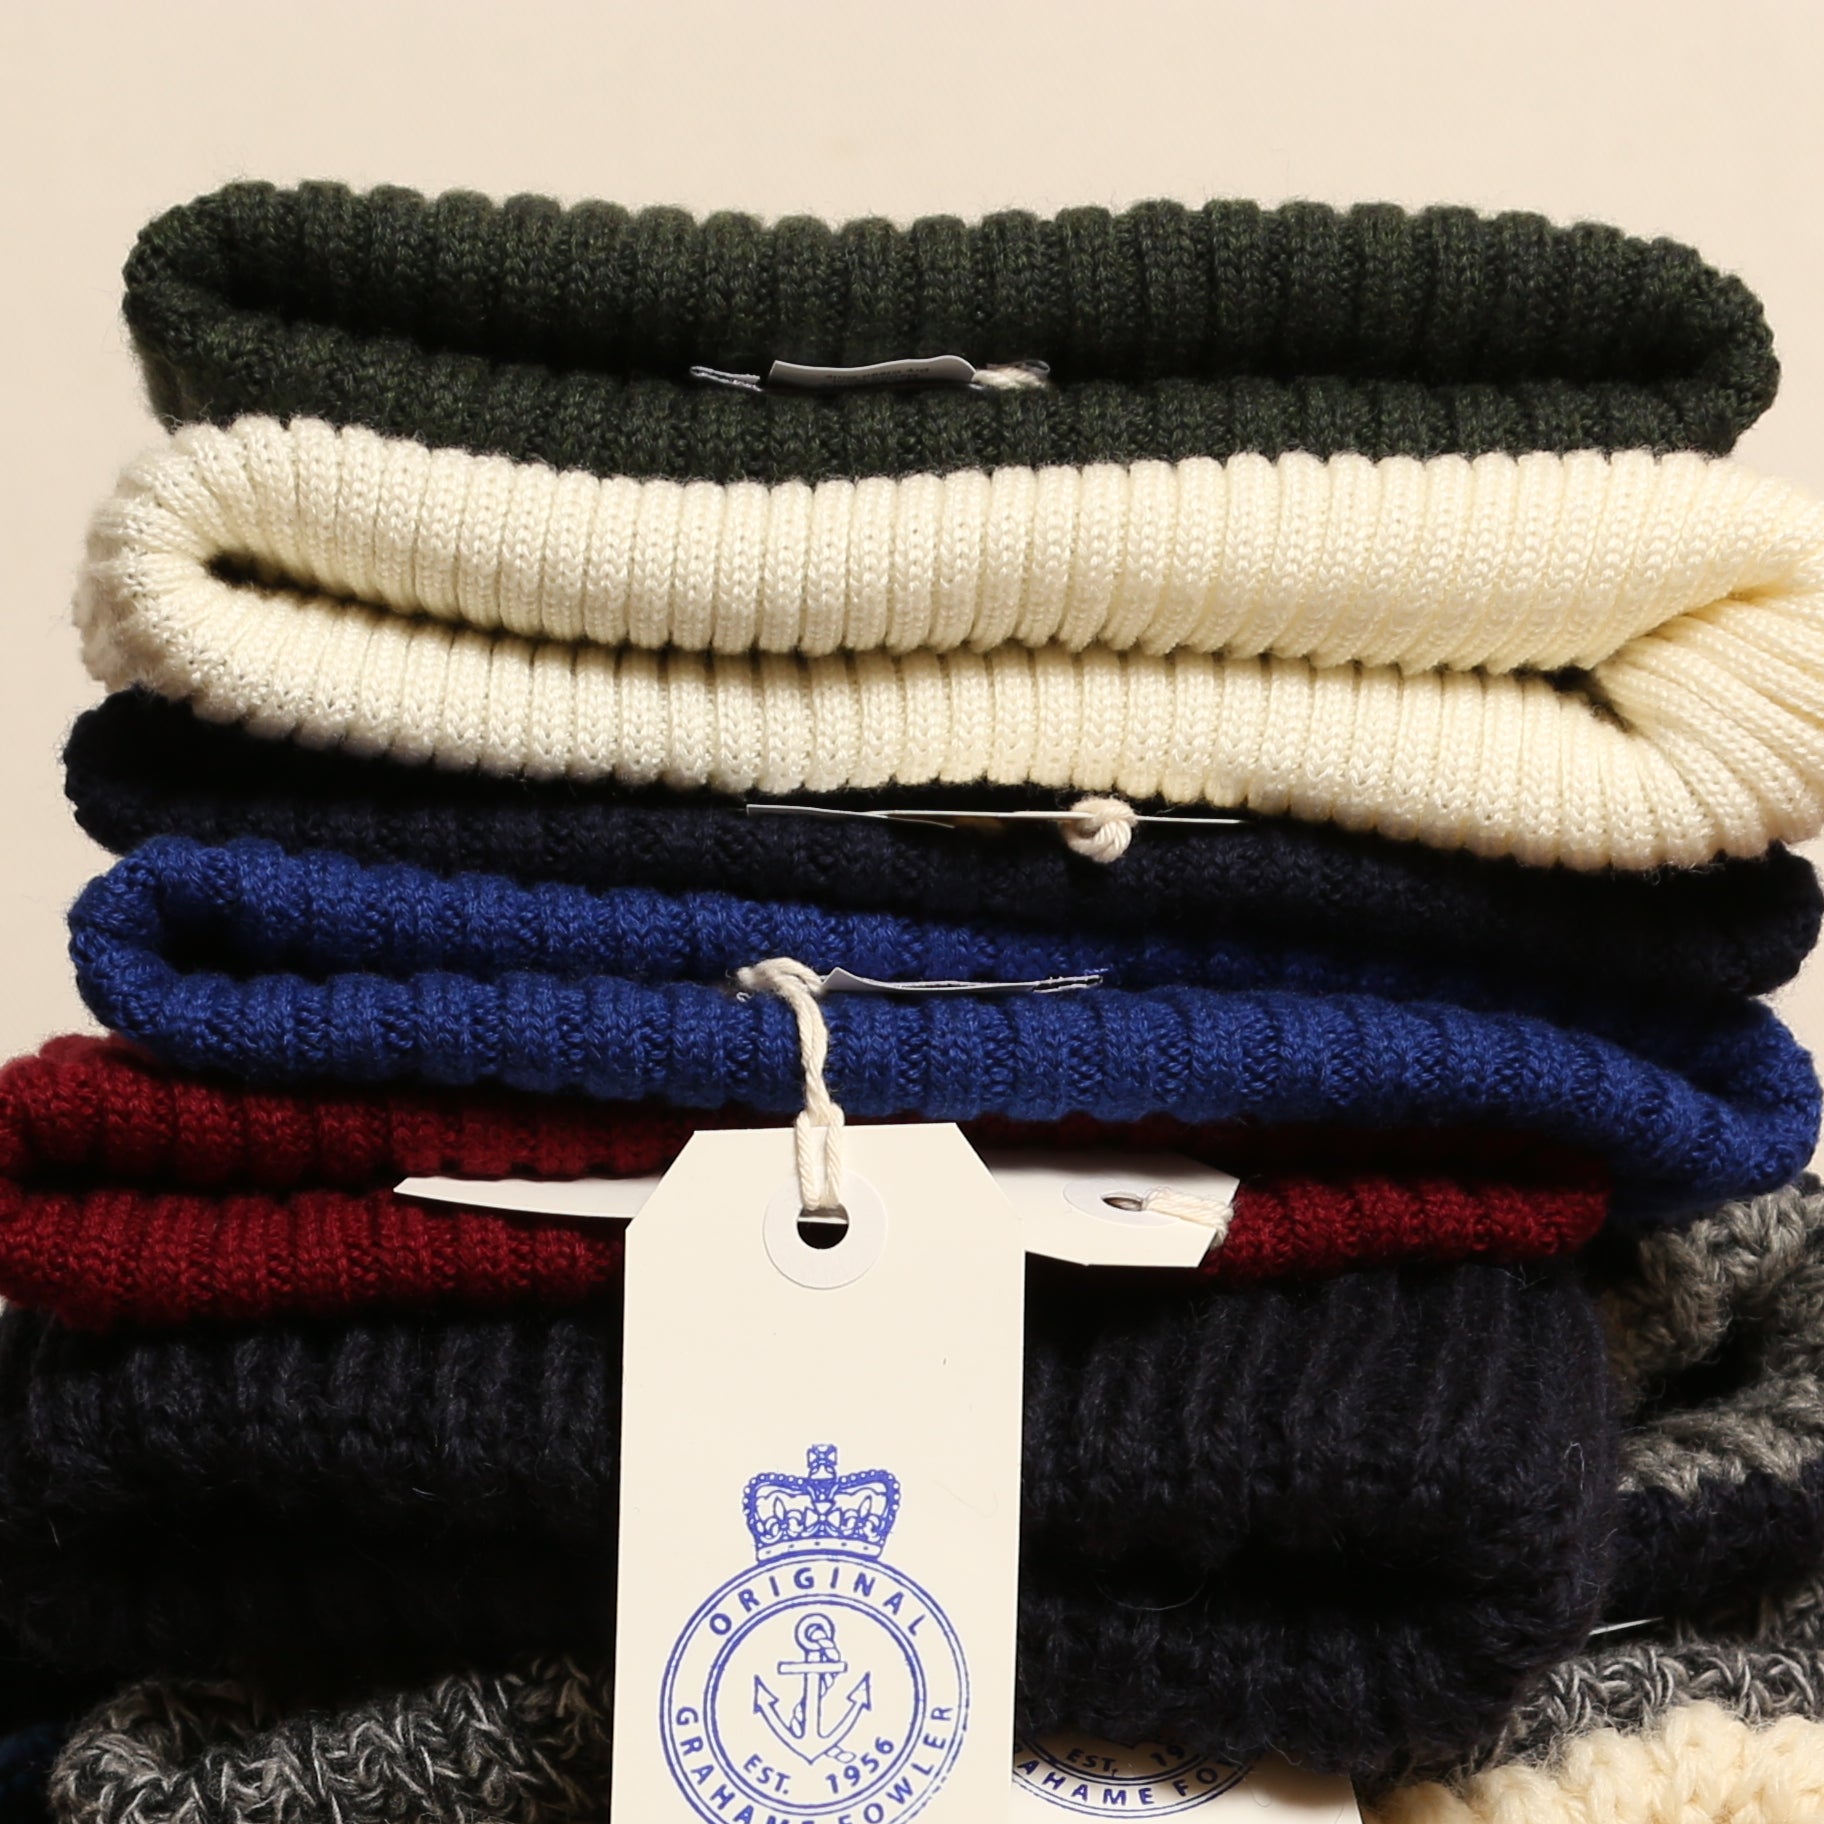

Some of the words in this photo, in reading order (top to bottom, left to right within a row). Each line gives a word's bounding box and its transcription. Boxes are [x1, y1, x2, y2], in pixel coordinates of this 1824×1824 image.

[708, 1567, 925, 1636] ORIGINAL
[743, 1753, 791, 1795] EST.
[826, 1737, 895, 1794] 1956
[1014, 1743, 1154, 1806] AHAME
[1150, 1744, 1186, 1767] 19
